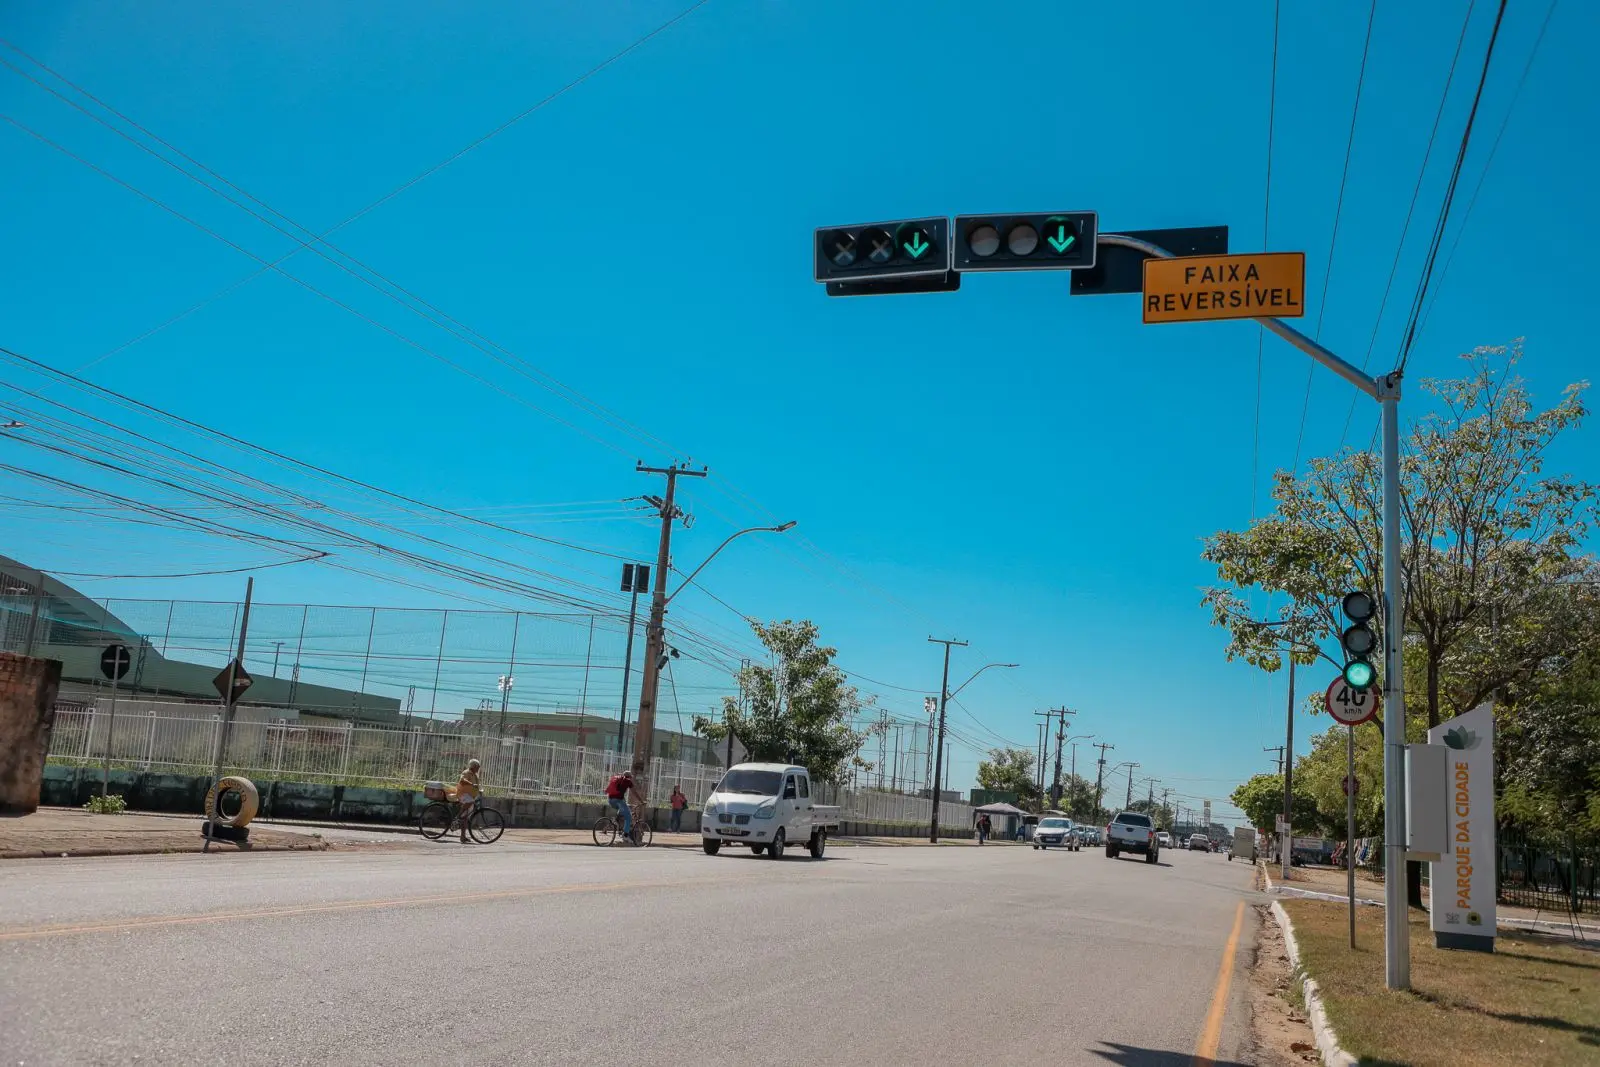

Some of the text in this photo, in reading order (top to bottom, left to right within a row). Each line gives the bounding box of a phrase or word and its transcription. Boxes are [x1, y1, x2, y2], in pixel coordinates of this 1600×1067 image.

[1185, 263, 1260, 285] FAIXA
[1147, 283, 1298, 312] REVERSÍVEL
[1336, 686, 1366, 707] 40
[1344, 707, 1362, 715] km/h
[1455, 762, 1473, 909] PARQUE DA CIDADE
